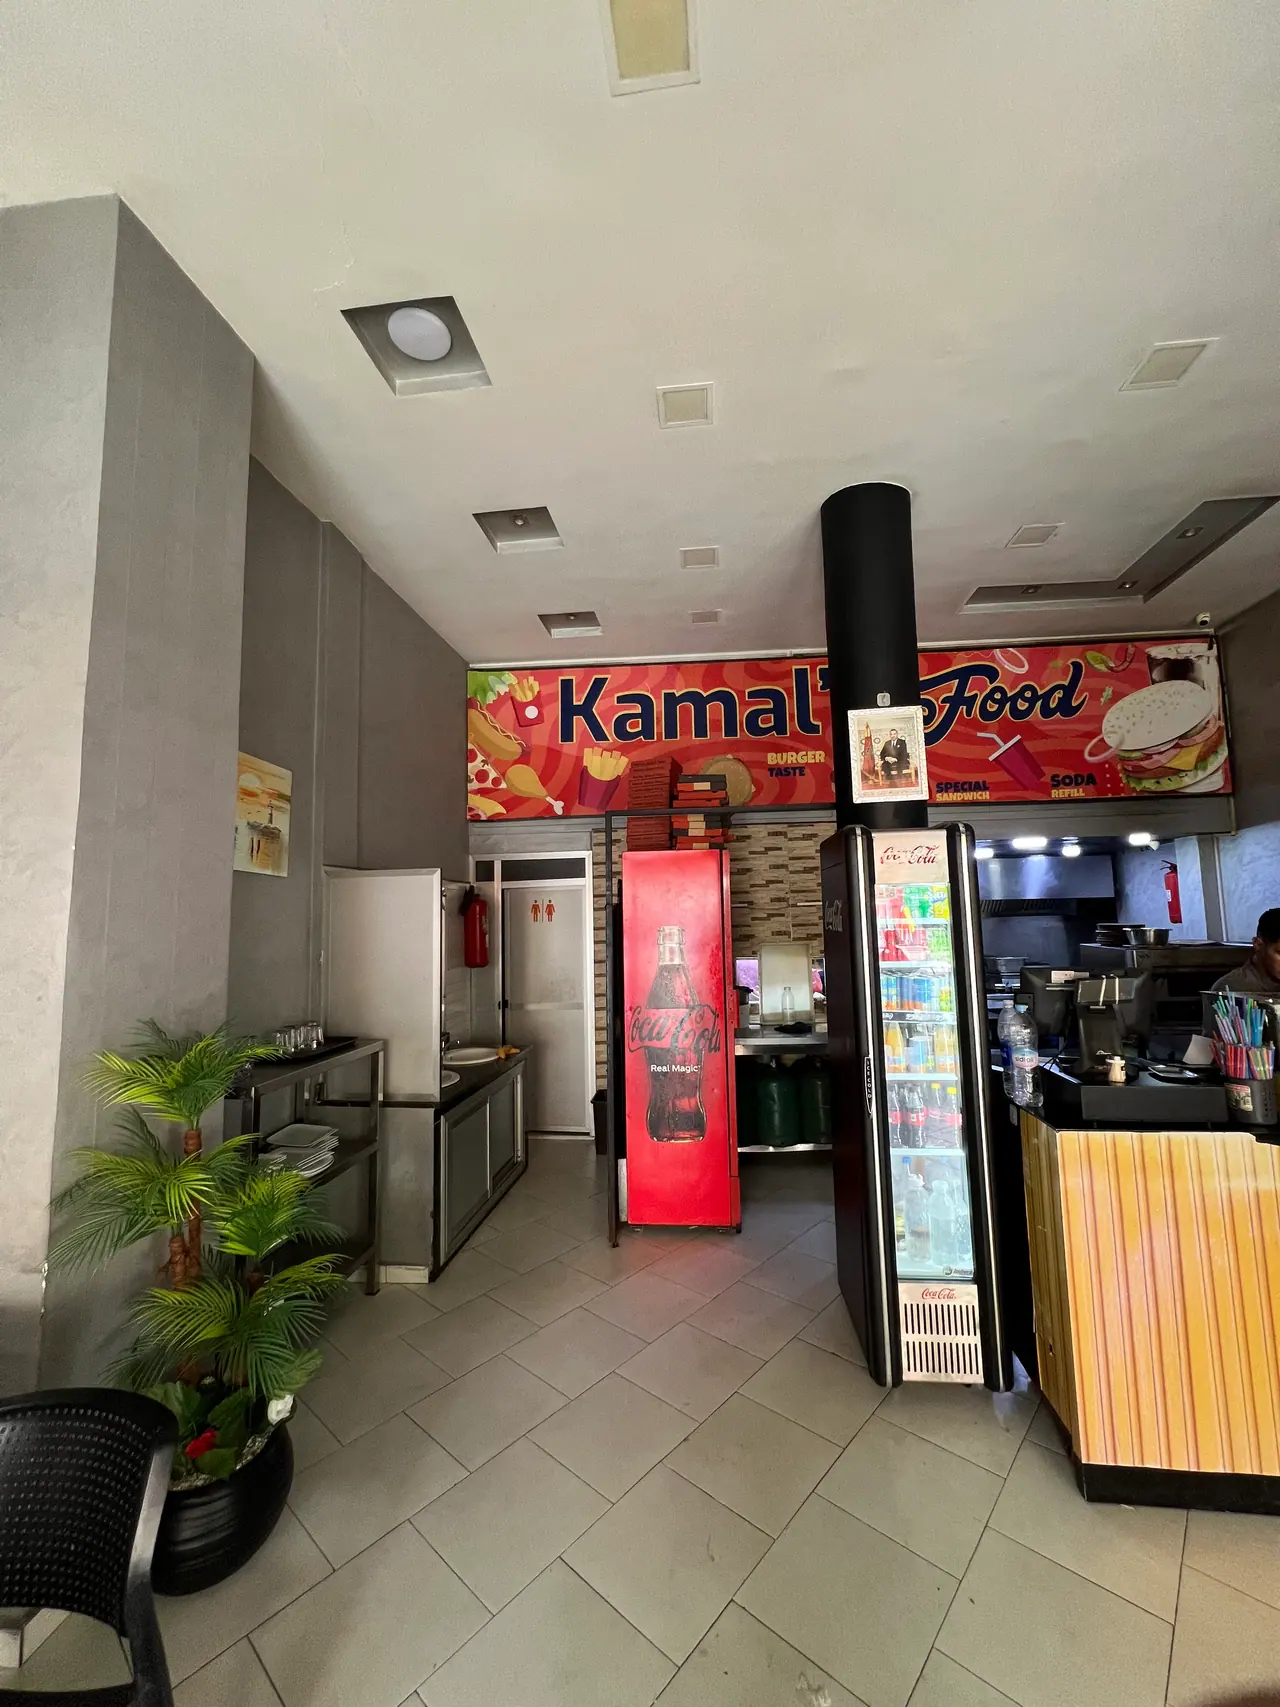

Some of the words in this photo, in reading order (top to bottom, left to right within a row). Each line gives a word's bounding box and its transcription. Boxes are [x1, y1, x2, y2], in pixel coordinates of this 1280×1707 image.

[919, 659, 1089, 748] Food
[767, 750, 826, 765] BURGER
[767, 766, 806, 778] TASTE
[1050, 772, 1097, 788] SODA
[935, 780, 990, 793] SPECIAL
[935, 791, 990, 802] SANDWICH
[1051, 788, 1085, 798] REFILL
[650, 1064, 671, 1073] Real
[672, 1064, 699, 1074] Magic
